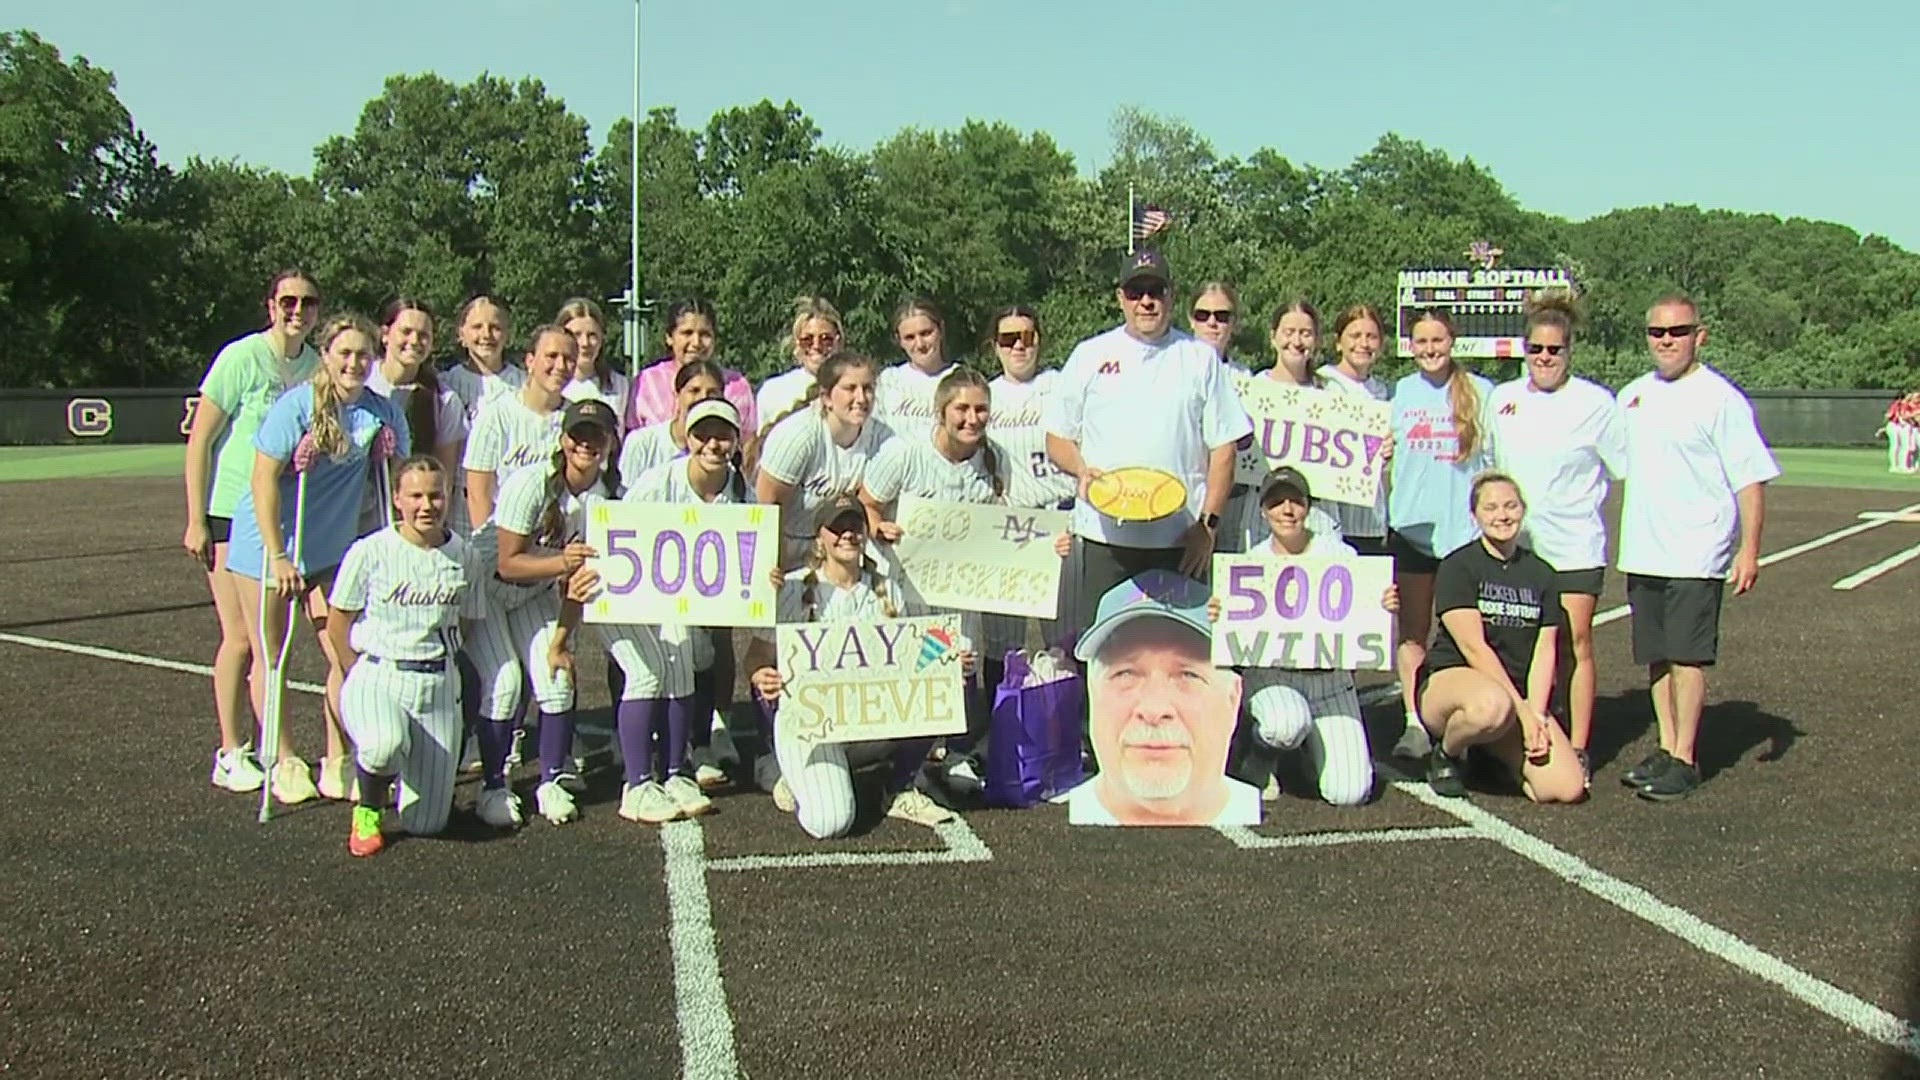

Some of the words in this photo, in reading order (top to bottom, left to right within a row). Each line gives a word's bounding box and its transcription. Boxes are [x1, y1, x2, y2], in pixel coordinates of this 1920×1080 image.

[1400, 270, 1468, 286] MUSKIE
[1473, 269, 1568, 286] SOFTBALL
[1237, 418, 1384, 476] UBS!
[908, 506, 971, 542] GO
[607, 529, 758, 600] 500!
[1227, 565, 1354, 622] 500
[795, 623, 907, 672] YAY
[1225, 631, 1386, 670] WINS
[799, 676, 954, 730] STEVE
